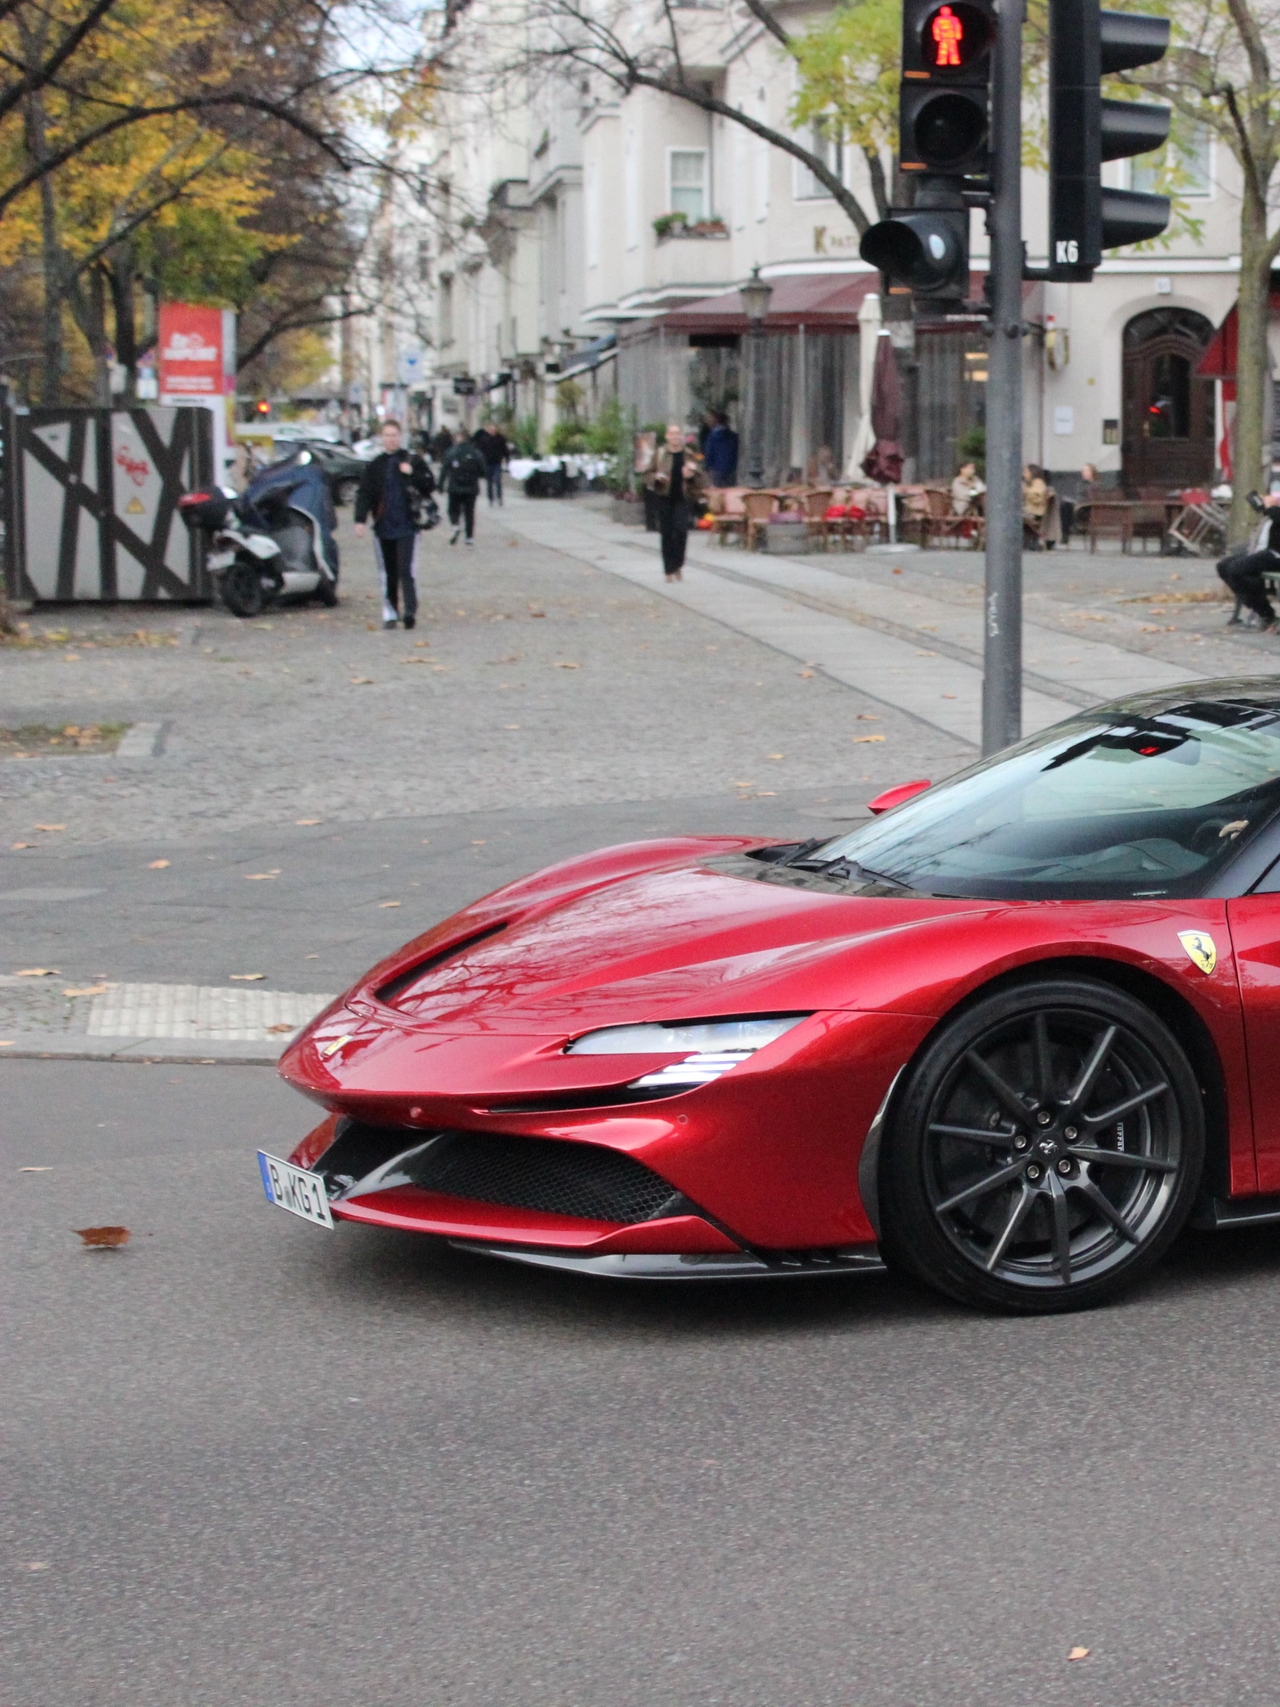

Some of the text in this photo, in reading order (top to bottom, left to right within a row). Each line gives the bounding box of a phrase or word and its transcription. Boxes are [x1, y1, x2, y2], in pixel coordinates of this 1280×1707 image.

[1056, 240, 1078, 263] K6
[1116, 1121, 1125, 1152] Ferrar
[269, 1163, 283, 1201] B
